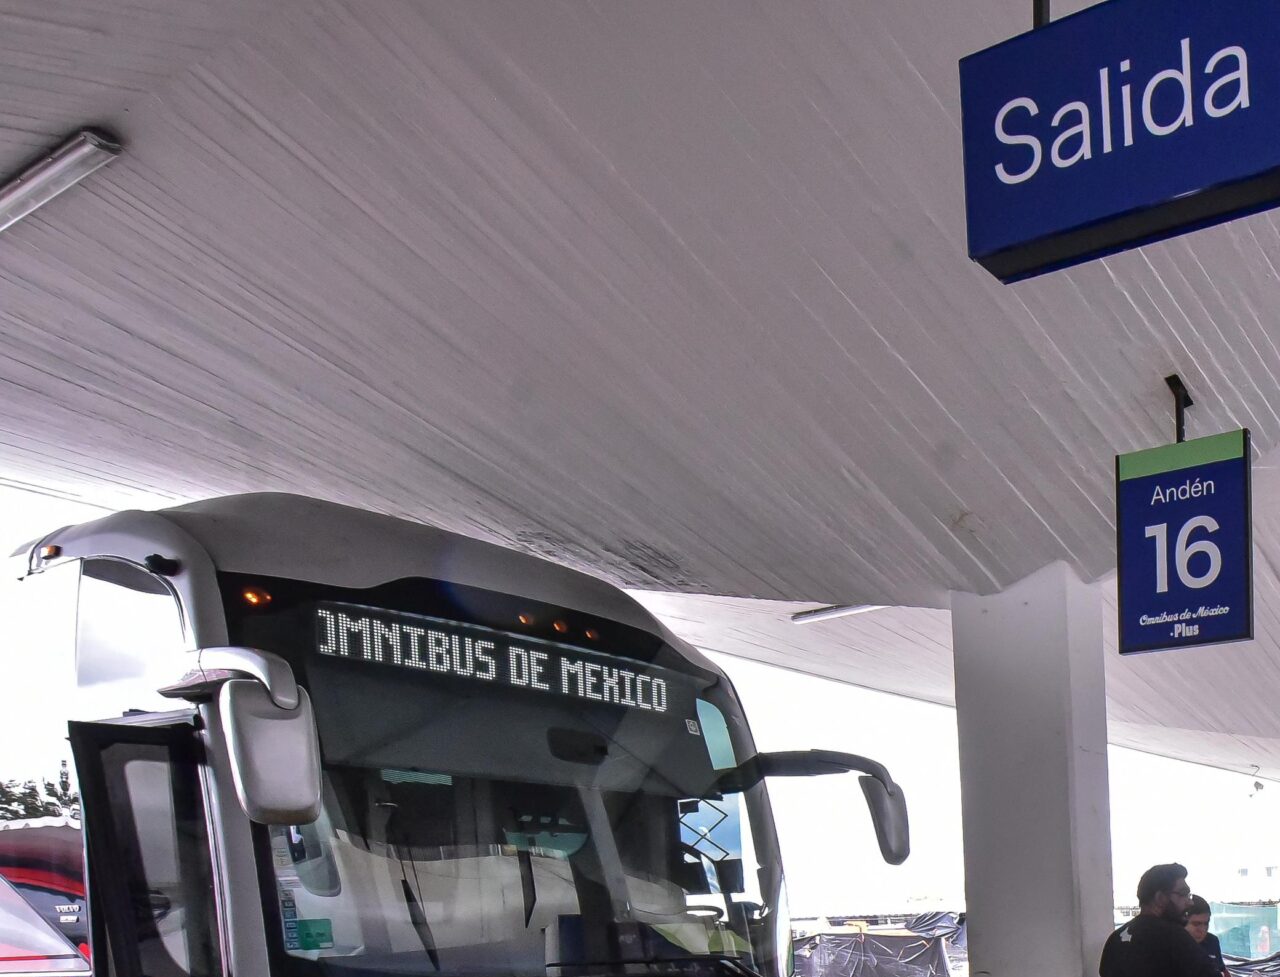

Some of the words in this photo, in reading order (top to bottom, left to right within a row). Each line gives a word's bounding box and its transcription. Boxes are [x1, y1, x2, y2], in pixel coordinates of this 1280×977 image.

[994, 38, 1250, 184] Salida
[1151, 478, 1215, 505] Andén
[1144, 515, 1222, 593] 16
[1139, 611, 1178, 626] Omnibus
[1179, 608, 1192, 620] de
[1192, 605, 1230, 619] México
[508, 646, 550, 691] DE
[560, 656, 667, 712] MEXICO
